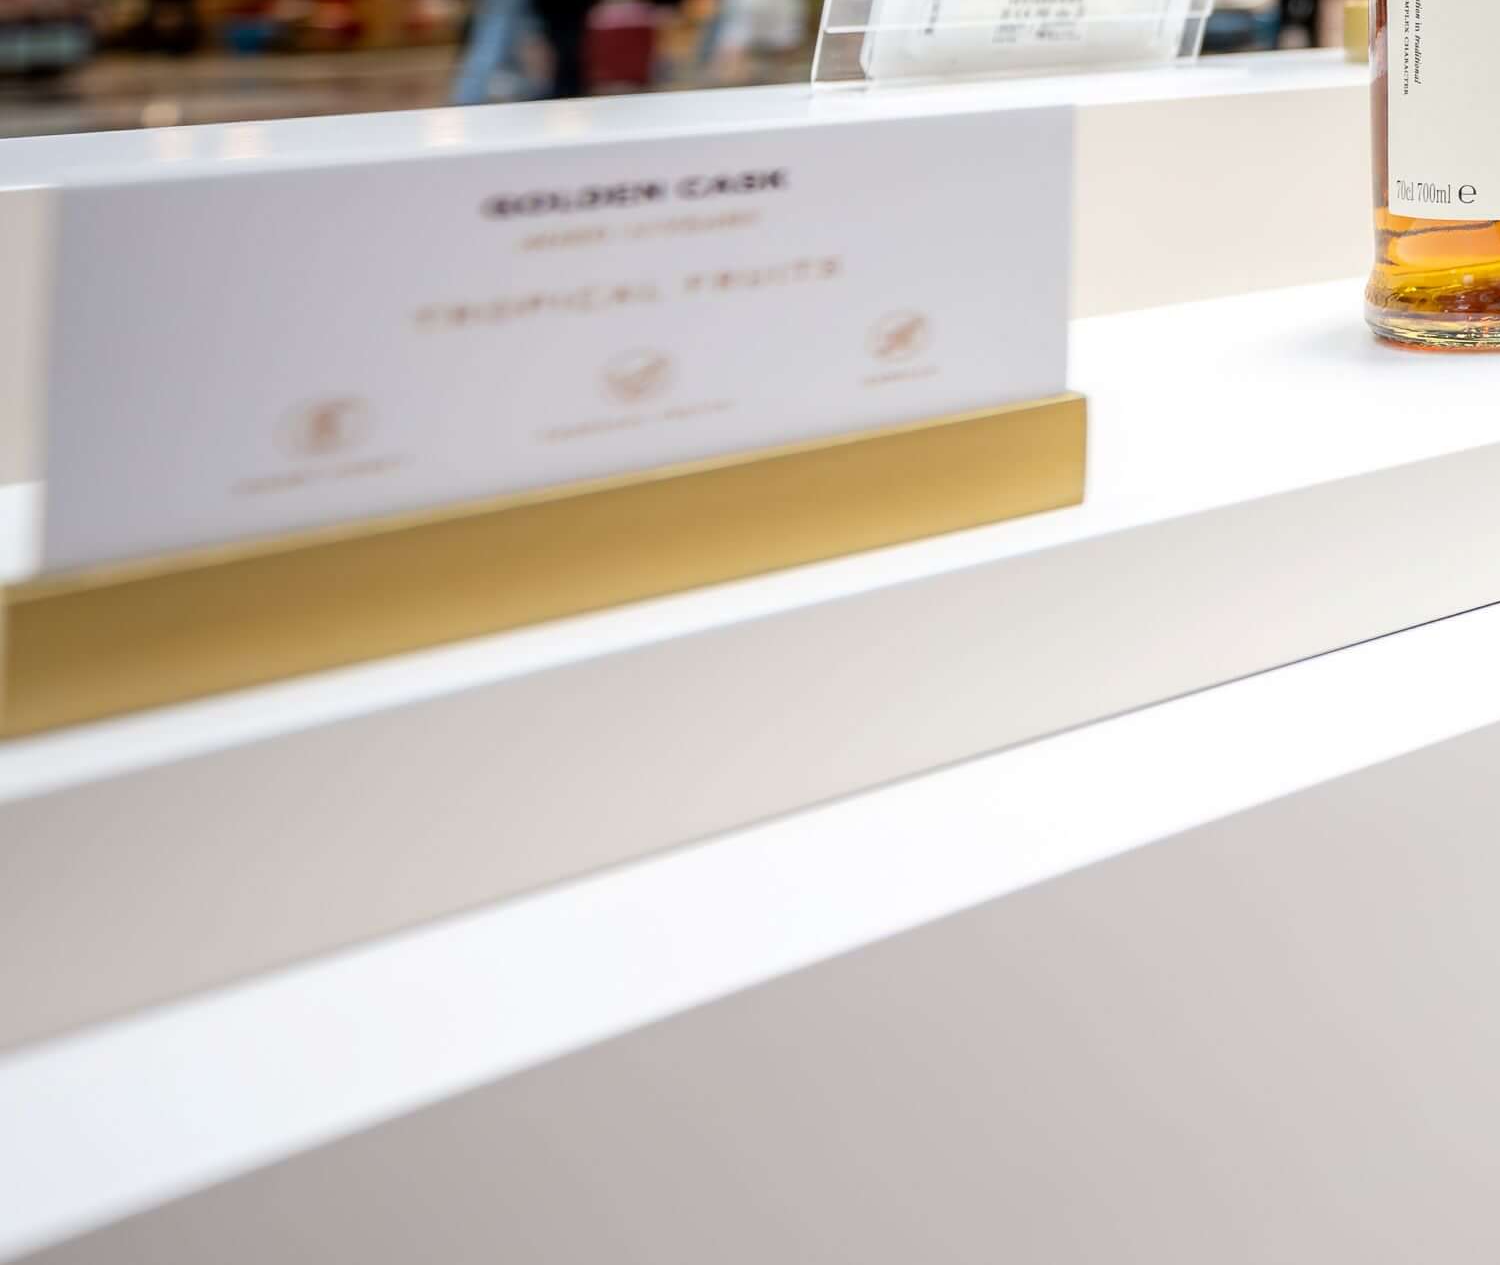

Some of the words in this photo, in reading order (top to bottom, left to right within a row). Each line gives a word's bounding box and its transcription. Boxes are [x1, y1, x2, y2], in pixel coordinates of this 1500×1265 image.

[1413, 35, 1423, 84] traditional
[481, 179, 667, 221] GOLDEN
[675, 167, 790, 201] CASK
[1396, 179, 1415, 201] 70cl
[1417, 182, 1452, 205] 700ml
